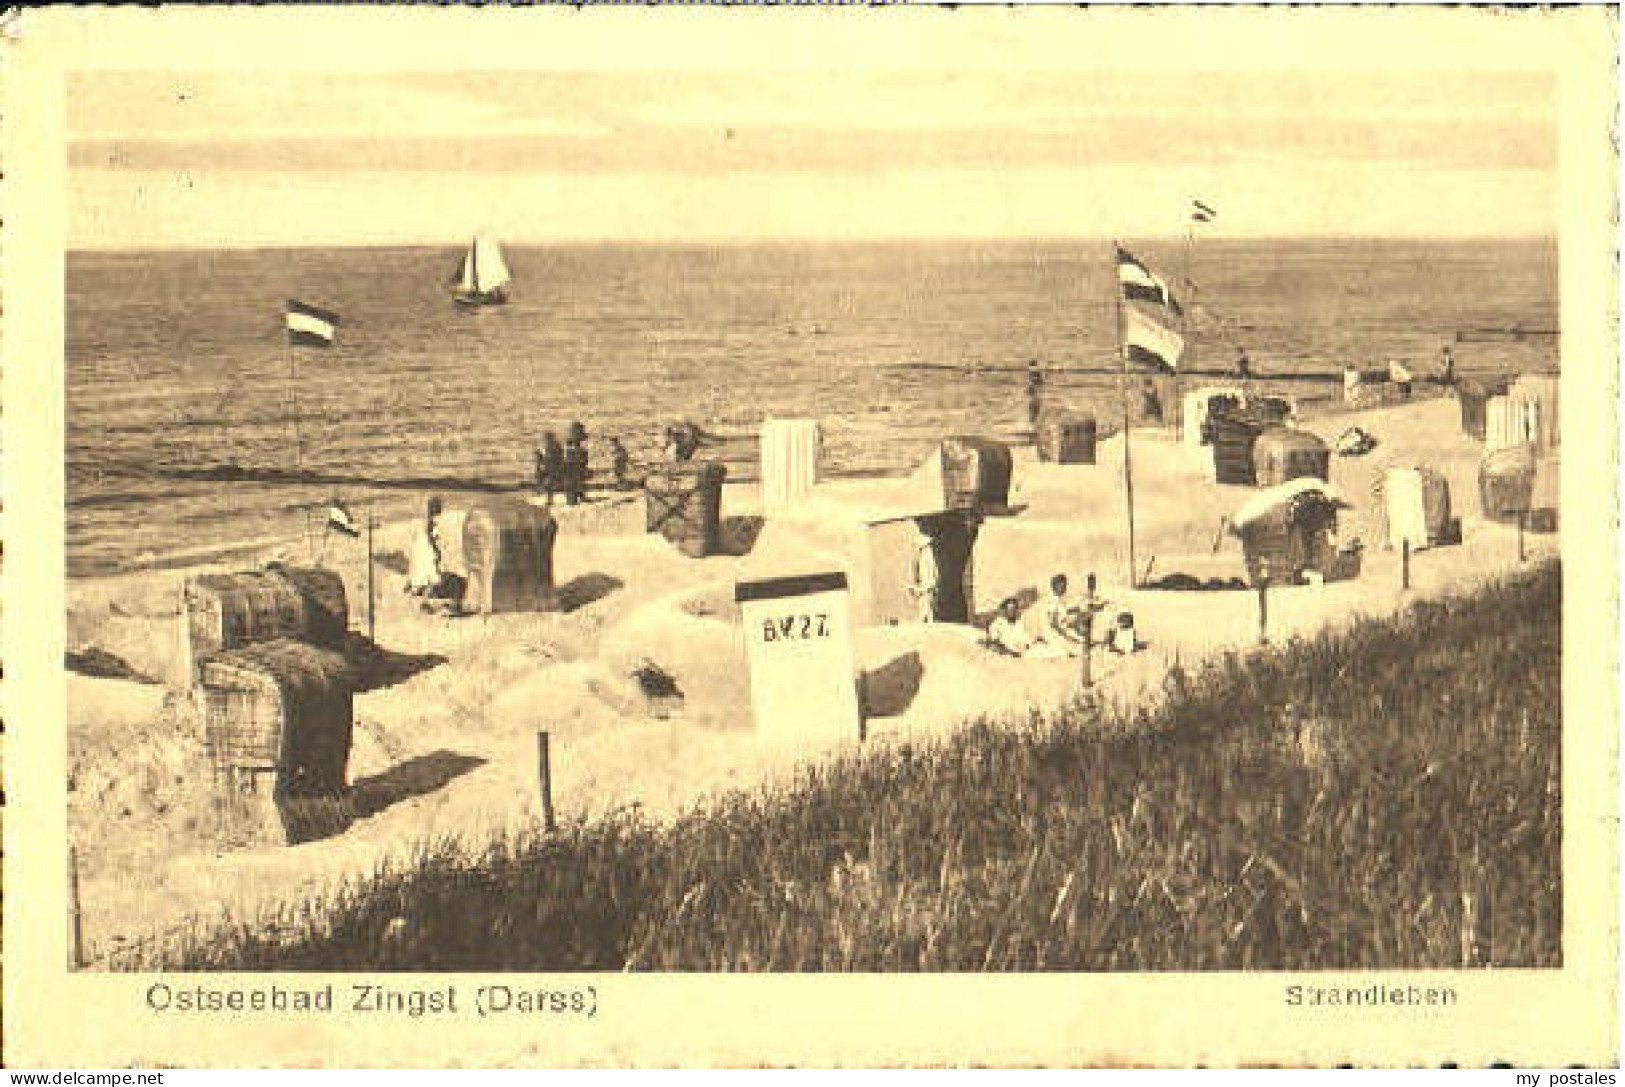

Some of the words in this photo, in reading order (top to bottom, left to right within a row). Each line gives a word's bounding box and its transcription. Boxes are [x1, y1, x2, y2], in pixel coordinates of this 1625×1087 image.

[146, 983, 333, 1012] Ostseebad
[352, 985, 457, 1016] Zingst
[475, 985, 598, 1017] (Darss)
[1285, 985, 1458, 1006] Strandleben
